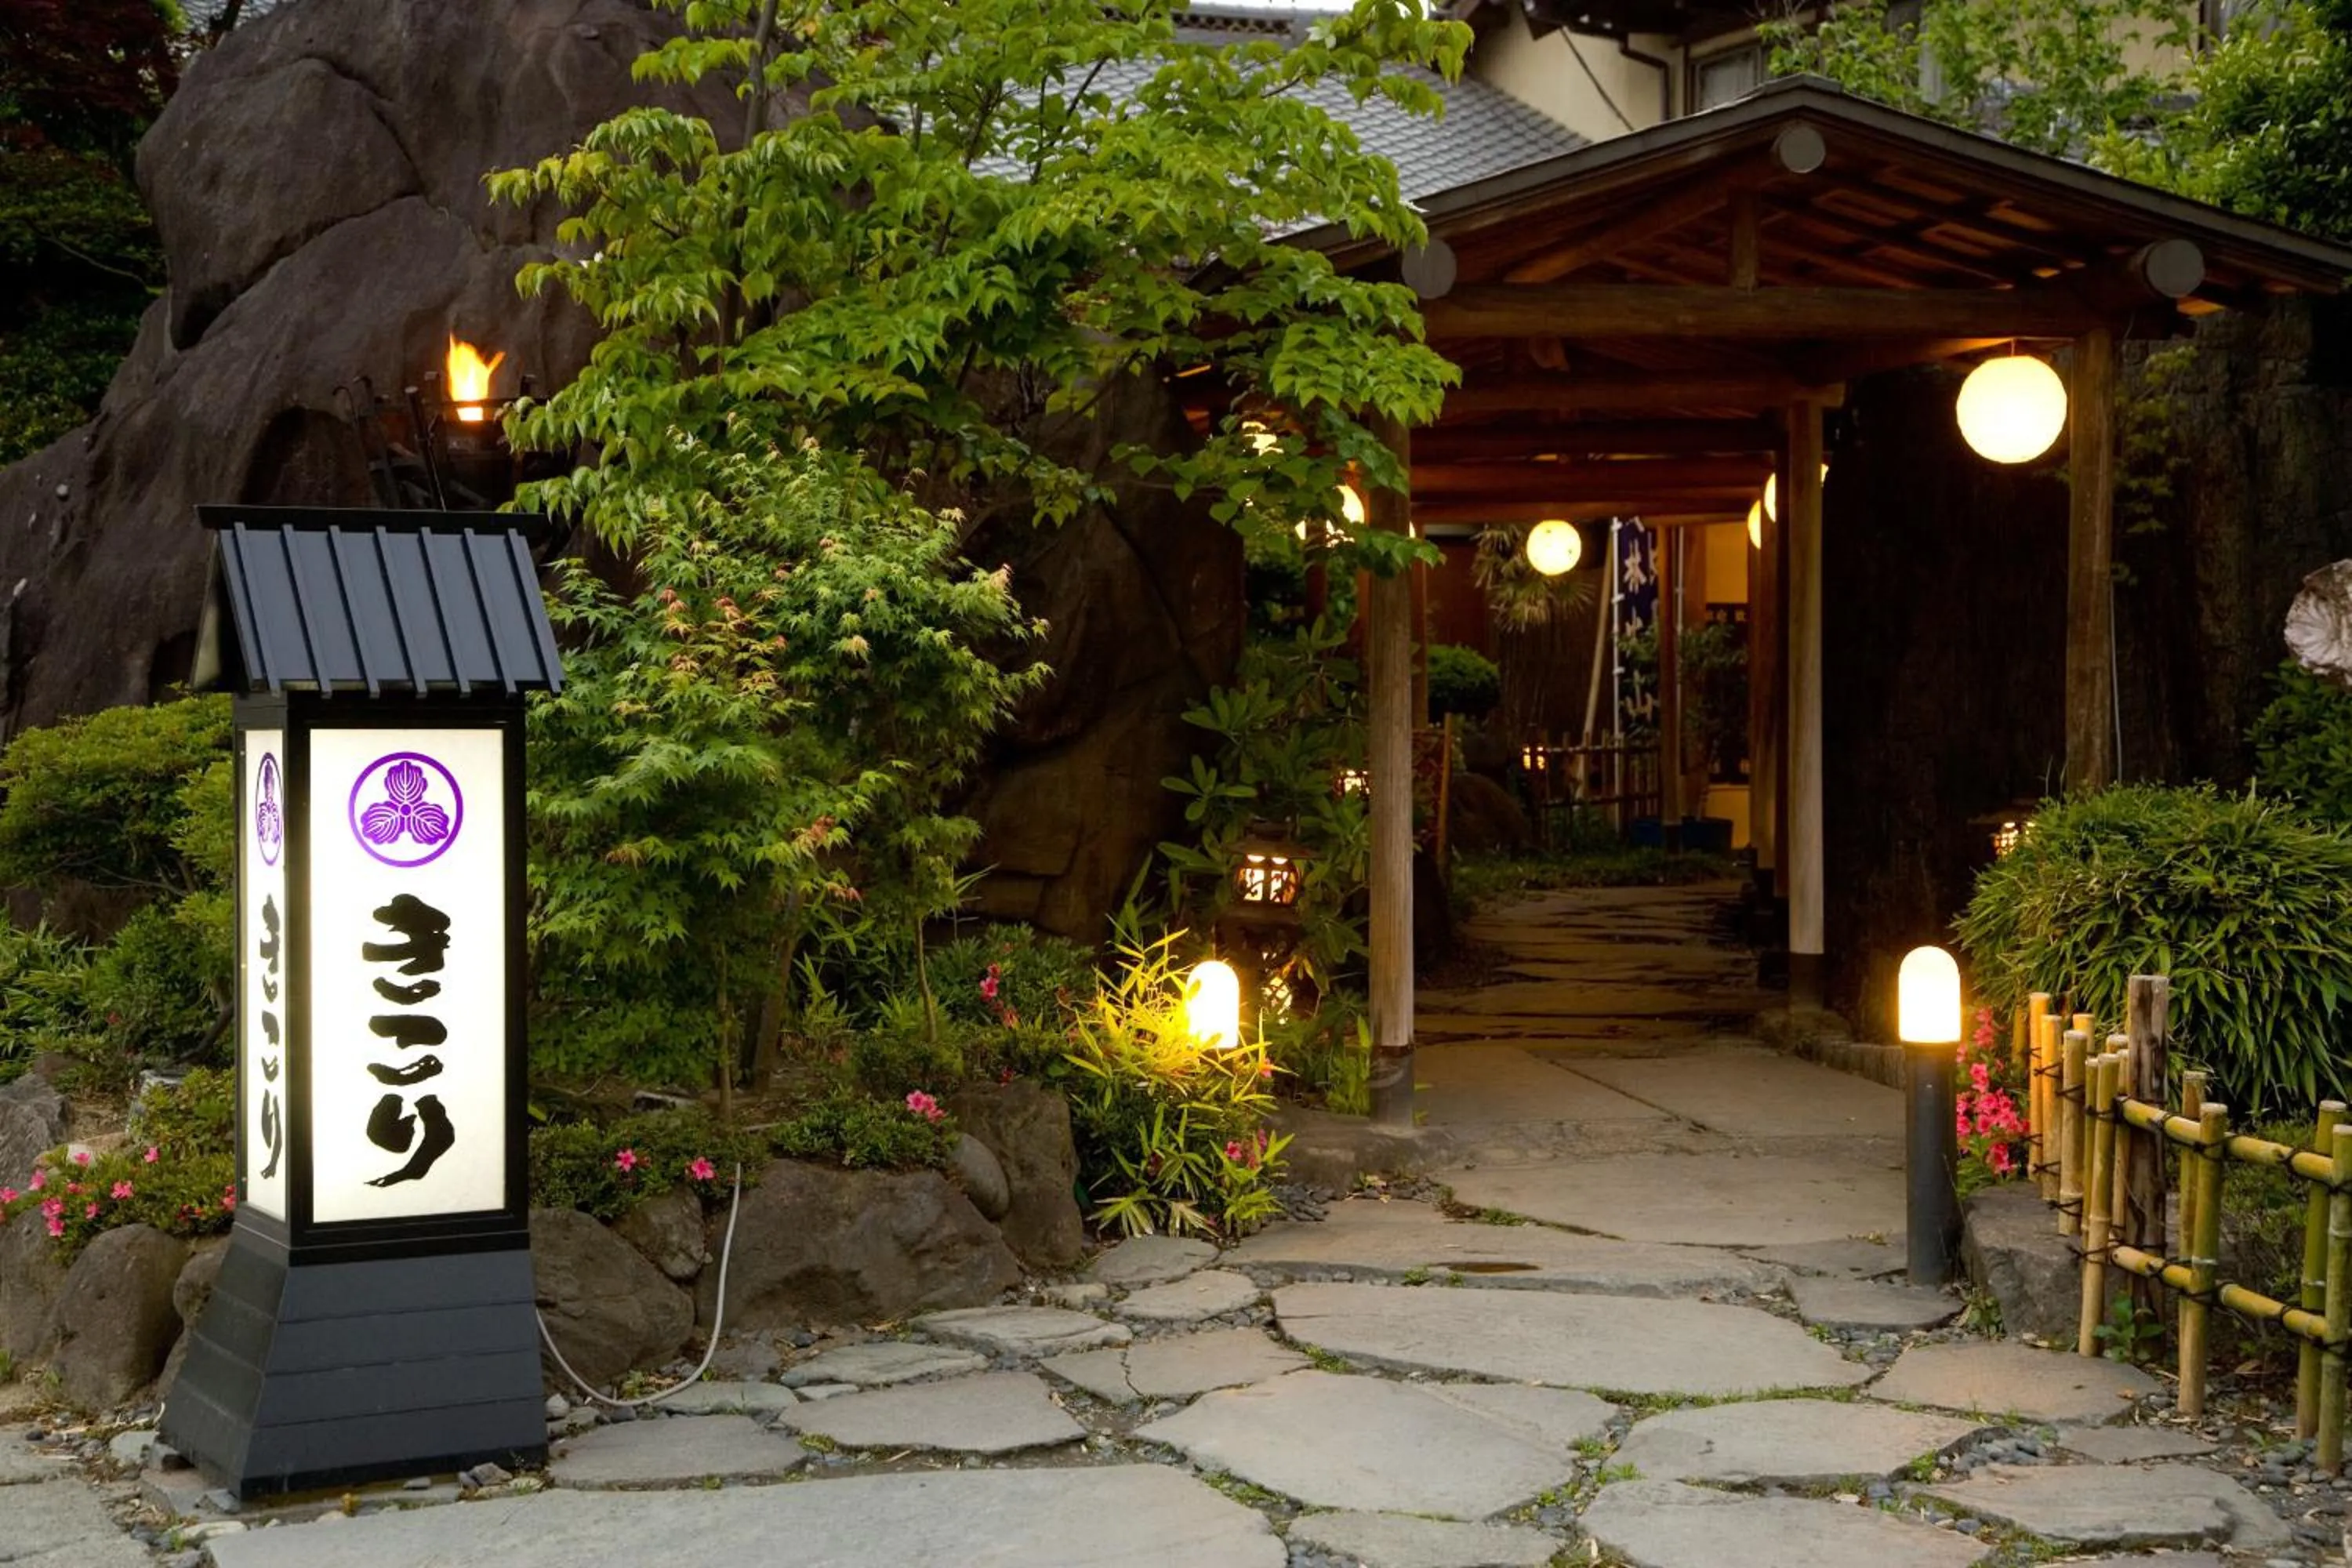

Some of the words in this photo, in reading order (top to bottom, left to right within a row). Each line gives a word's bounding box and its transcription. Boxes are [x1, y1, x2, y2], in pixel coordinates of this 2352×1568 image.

[260, 894, 283, 1180] きこり
[362, 893, 456, 1188] きこり
